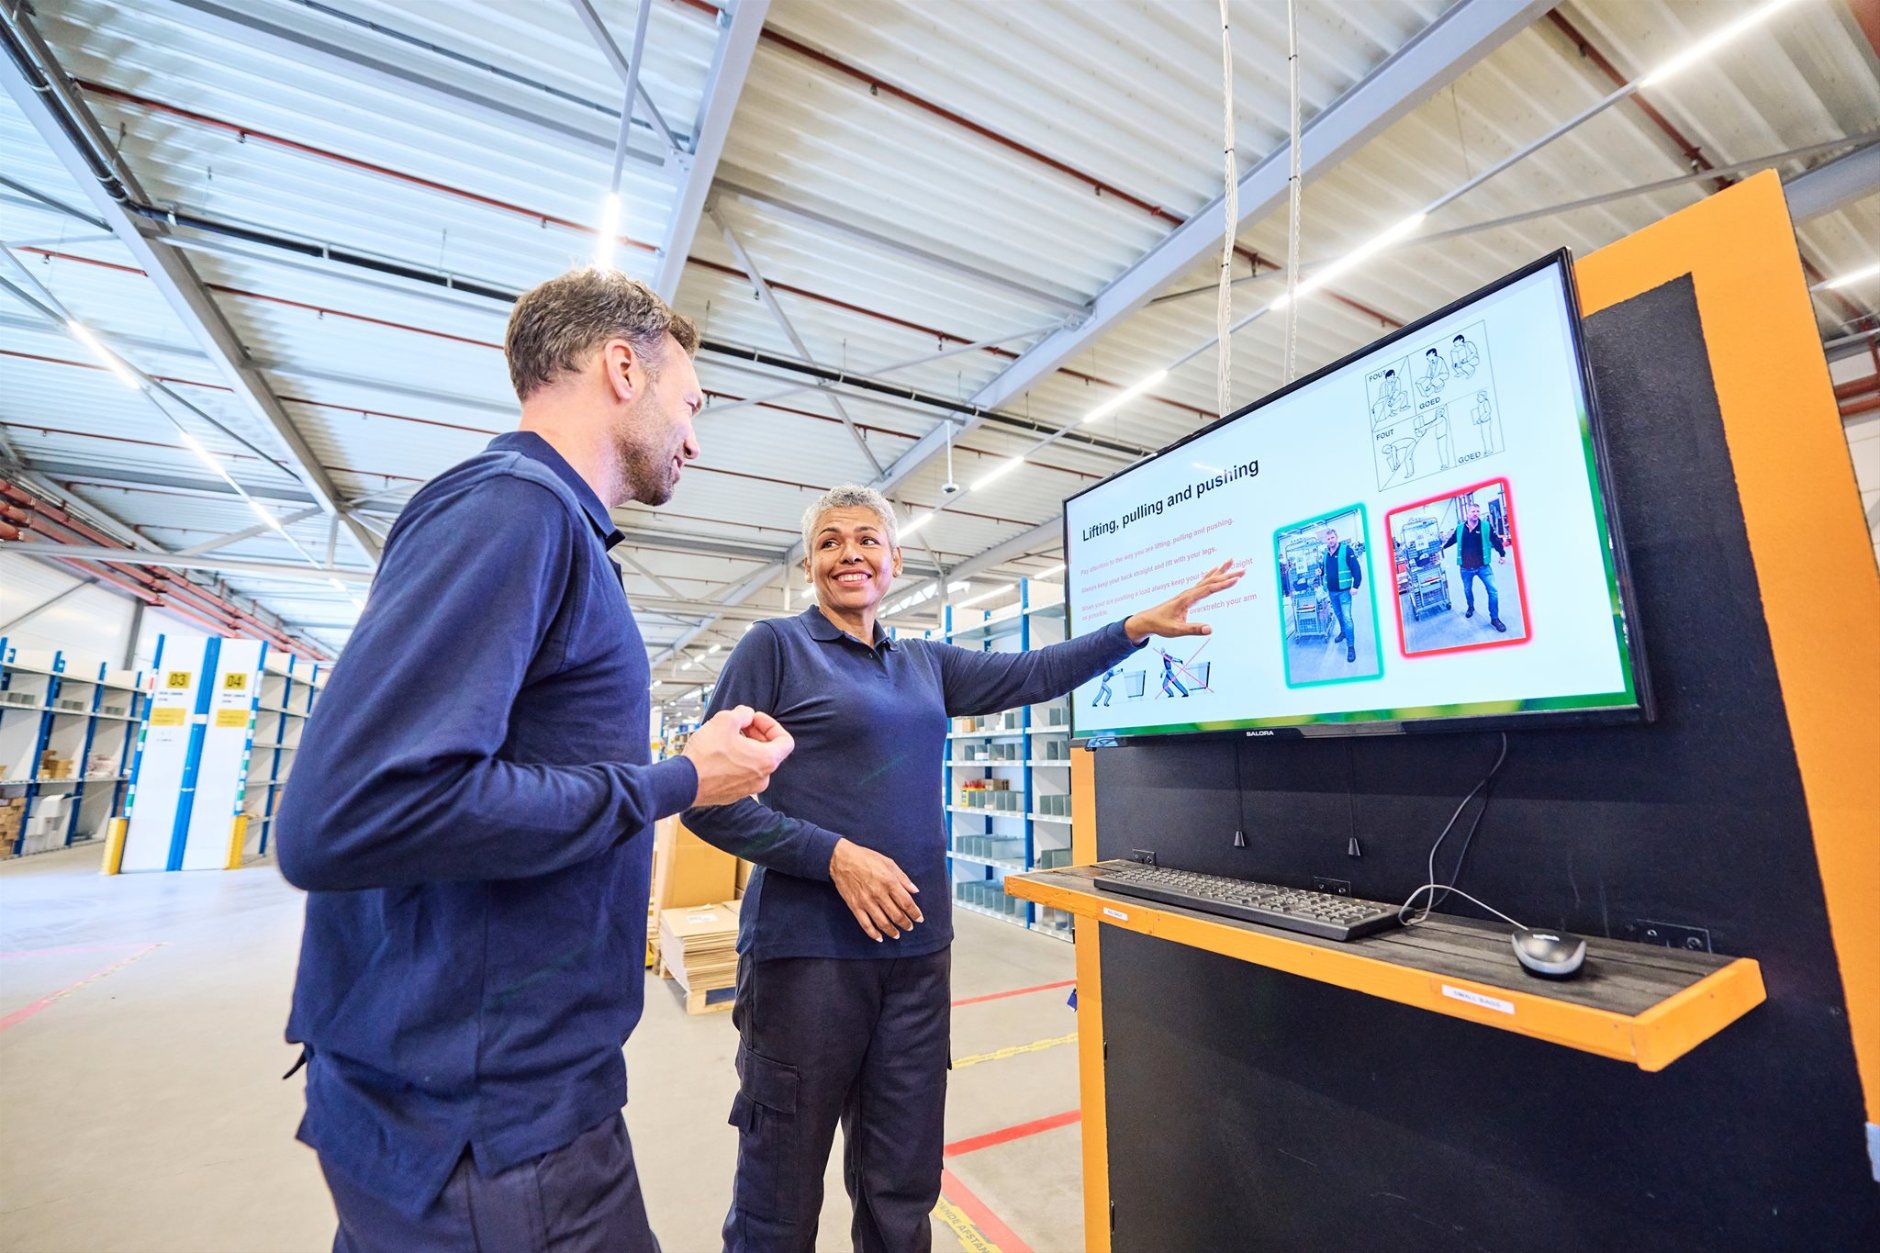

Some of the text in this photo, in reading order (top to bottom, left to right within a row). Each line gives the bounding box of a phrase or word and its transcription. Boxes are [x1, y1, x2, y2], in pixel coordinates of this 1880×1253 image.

[1369, 370, 1387, 382] FOUT
[1419, 396, 1441, 410] GOED
[1376, 429, 1394, 441] FOUT
[1458, 451, 1481, 464] GOED
[1082, 459, 1259, 541] Lifting, pulling and pushing
[1172, 532, 1192, 545] pulling
[1193, 527, 1205, 536] and
[1120, 572, 1132, 581] back
[1133, 565, 1153, 577] straight
[1154, 562, 1164, 570] and
[1165, 559, 1173, 567] lift
[1173, 555, 1186, 564] with
[1186, 551, 1201, 562] your
[1139, 587, 1151, 595] load
[1151, 583, 1170, 592] always
[1170, 578, 1185, 586] keep
[1185, 574, 1199, 584] your
[1189, 593, 1257, 614] overstretch your arm
[170, 673, 187, 686] 03
[227, 675, 242, 687] 04
